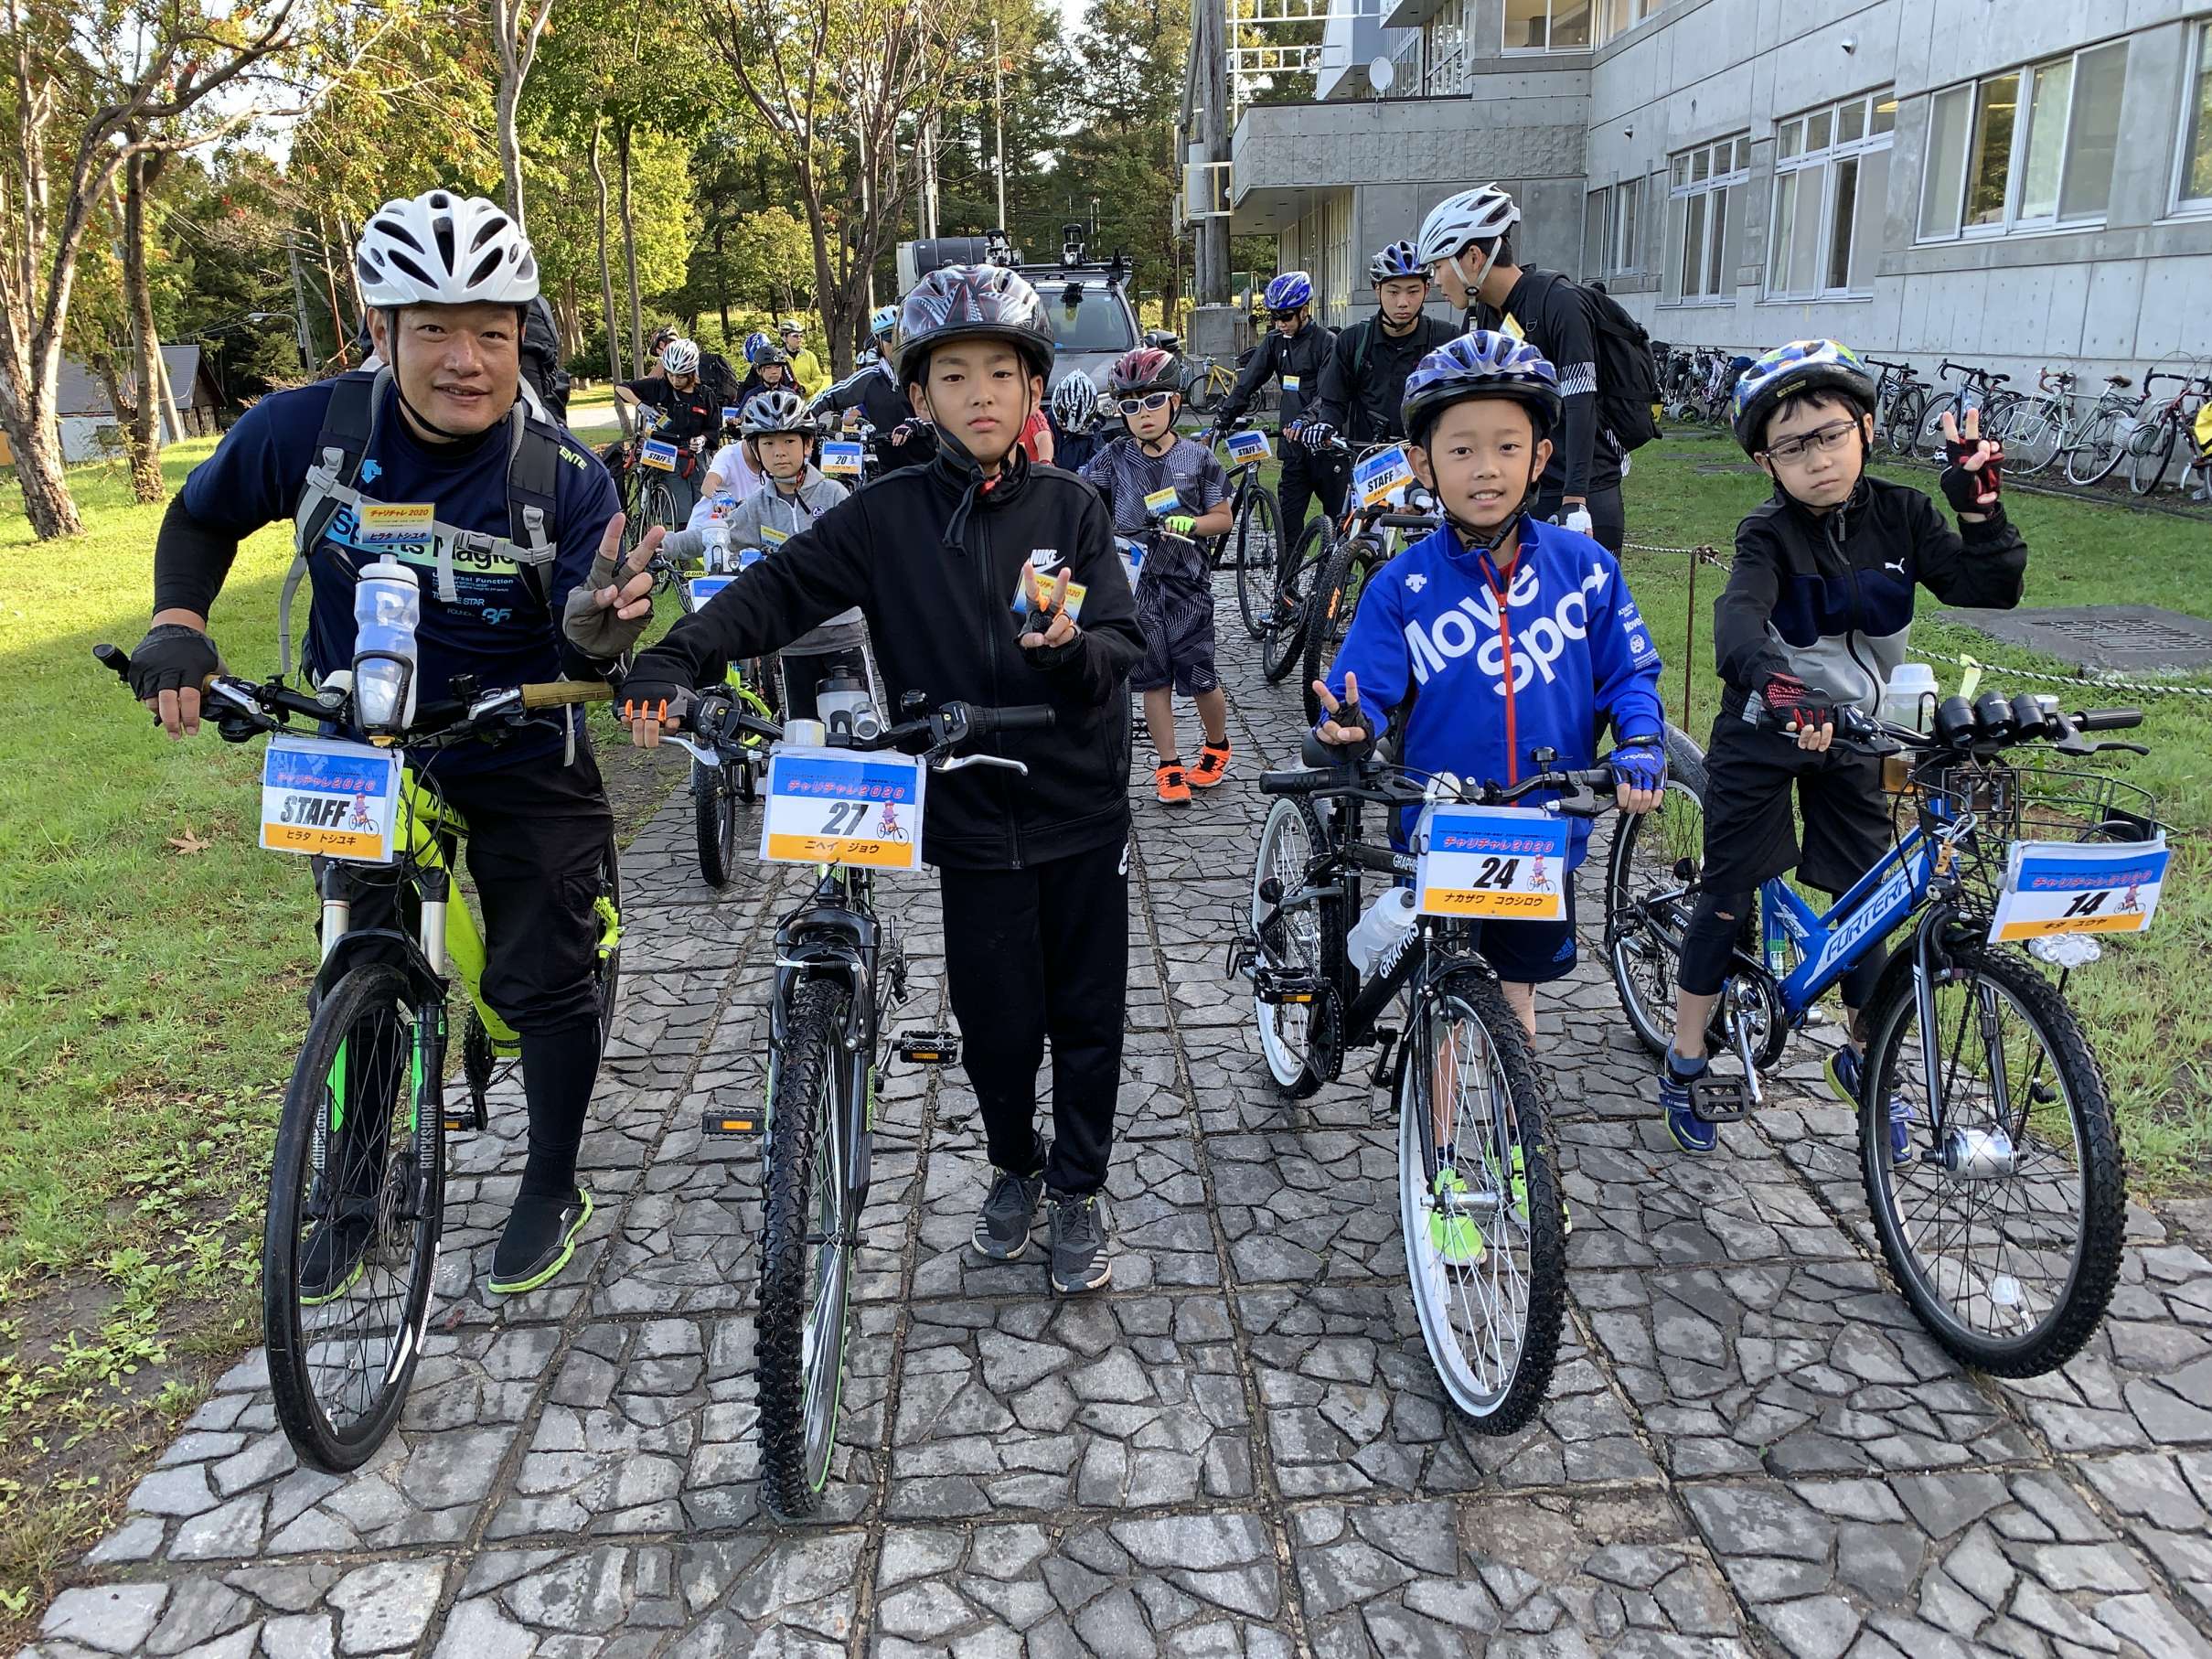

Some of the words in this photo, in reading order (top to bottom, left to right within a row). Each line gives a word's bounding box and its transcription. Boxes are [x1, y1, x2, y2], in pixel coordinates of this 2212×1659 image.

[559, 445, 588, 470] ENTE
[647, 453, 667, 462] STAFF
[835, 455, 848, 465] 20
[1237, 446, 1256, 455] STAFF
[1367, 470, 1395, 493] STAFF
[408, 508, 429, 517] 2020
[1030, 549, 1058, 566] NIKE
[463, 597, 485, 606] STAR
[1404, 563, 1540, 685] Move
[1477, 562, 1610, 697] Sport
[280, 795, 351, 828] STAFF
[820, 801, 870, 836] 27
[286, 830, 312, 841] ヒラタ
[320, 835, 357, 846] トシユキ
[847, 841, 880, 854] ジョウ
[1443, 836, 1555, 853] チャリチャレ2020
[1472, 856, 1521, 890] 24
[1444, 893, 1486, 904] ナカザワ
[1493, 895, 1544, 907] コウシロウ
[2062, 891, 2112, 918] 14
[1379, 922, 1420, 979] GRAPHIS
[419, 1104, 437, 1170] ROCKSHOX
